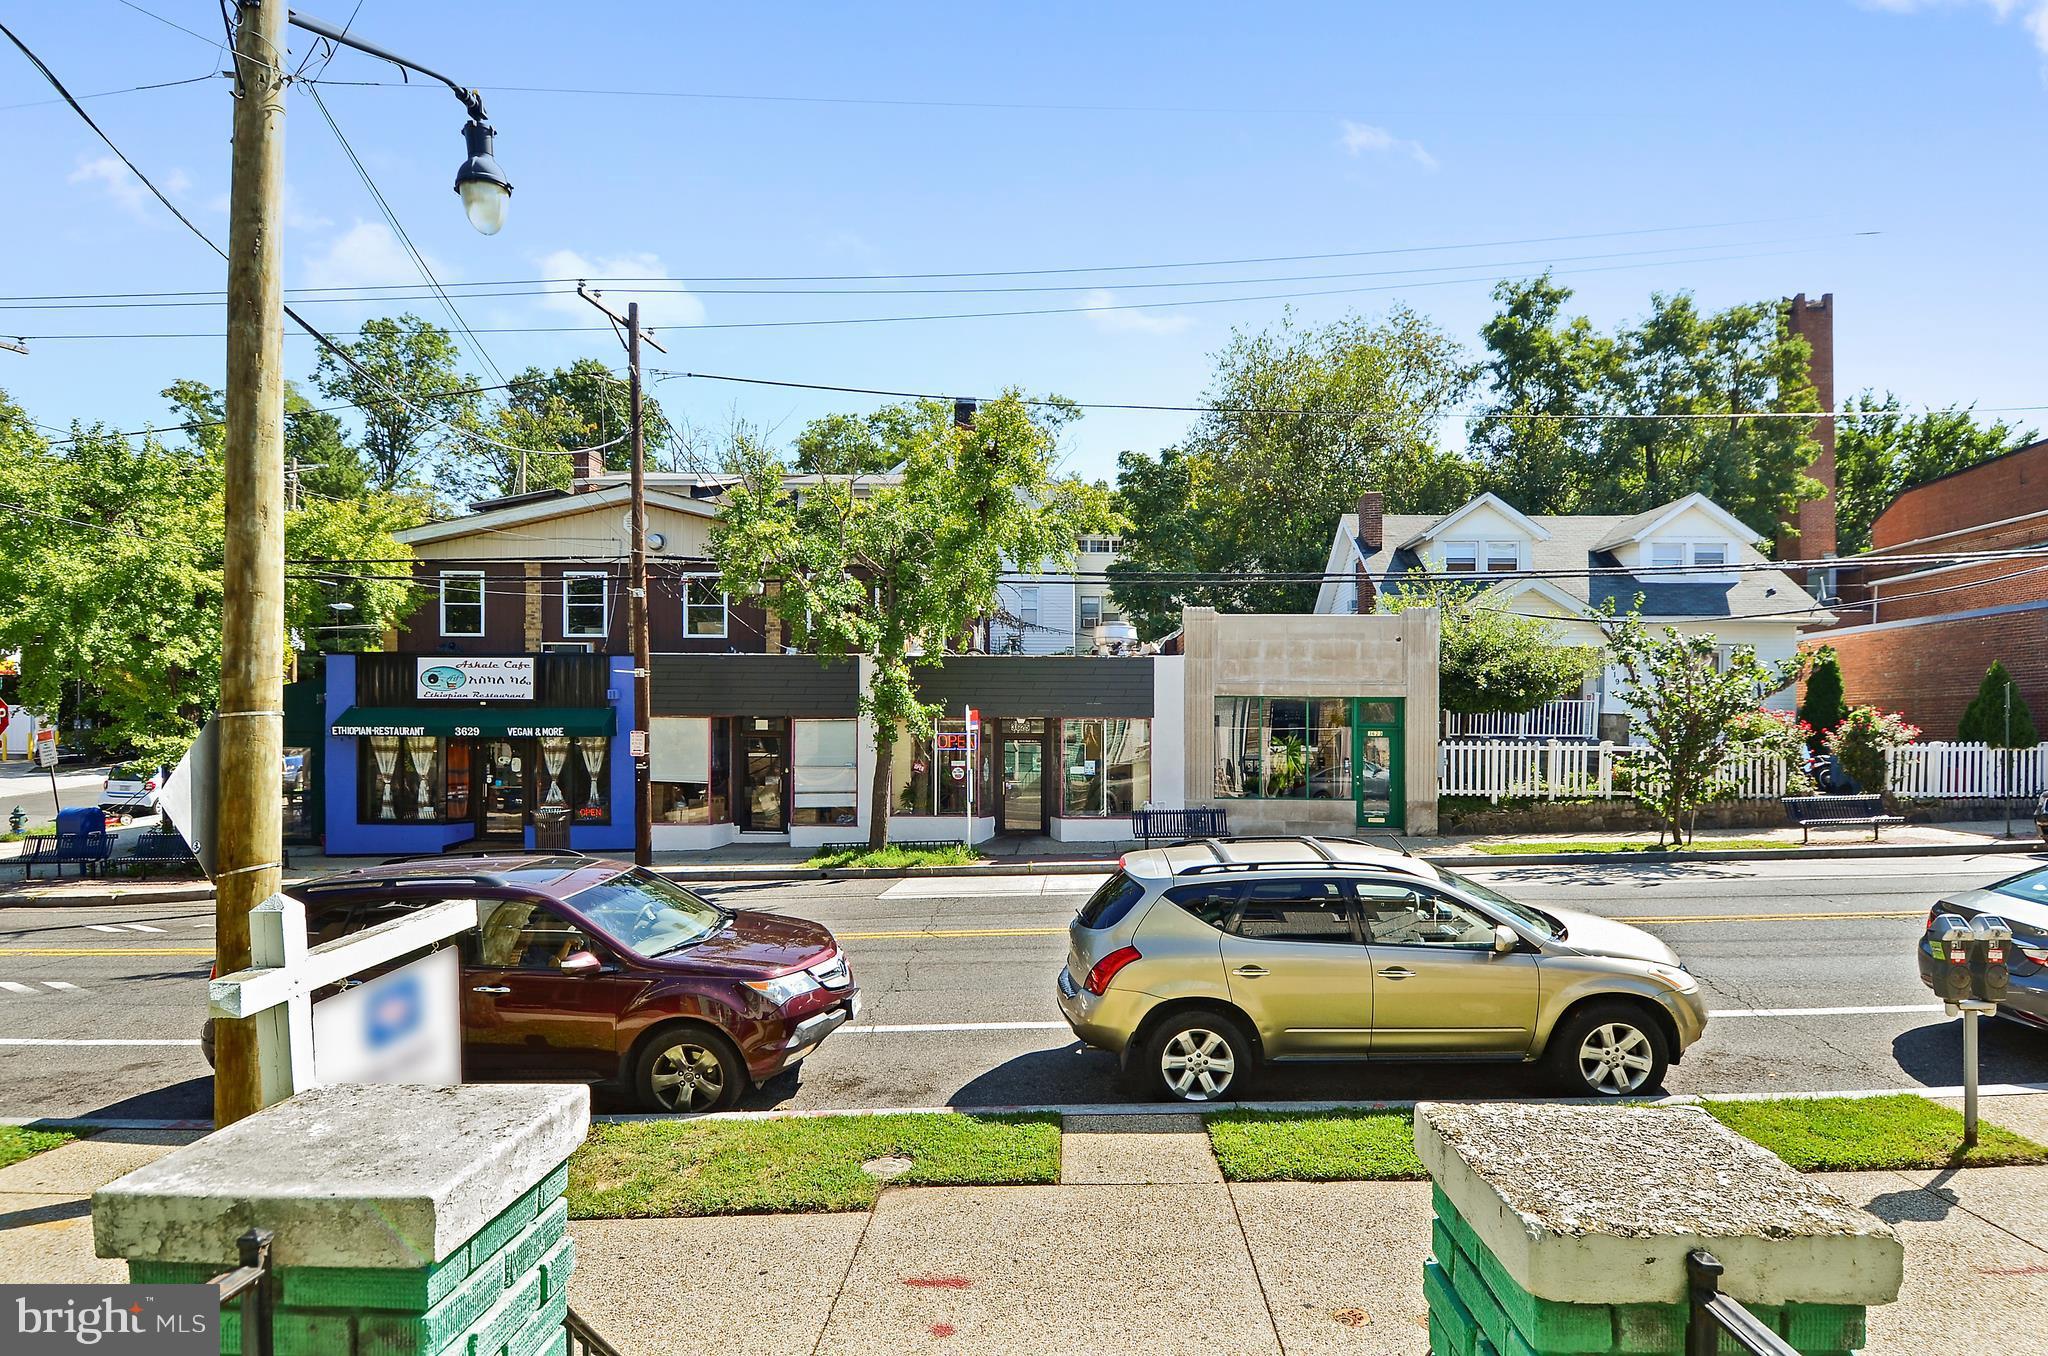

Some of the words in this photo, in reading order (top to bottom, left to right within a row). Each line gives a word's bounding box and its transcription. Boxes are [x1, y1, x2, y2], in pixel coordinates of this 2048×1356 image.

[504, 660, 531, 670] Cafe
[423, 691, 468, 699] Ethiopian
[454, 726, 480, 736] 3629
[507, 727, 534, 736] VEGAN
[534, 727, 541, 736] &
[542, 727, 564, 736] MORE
[580, 808, 602, 816] OPEN
